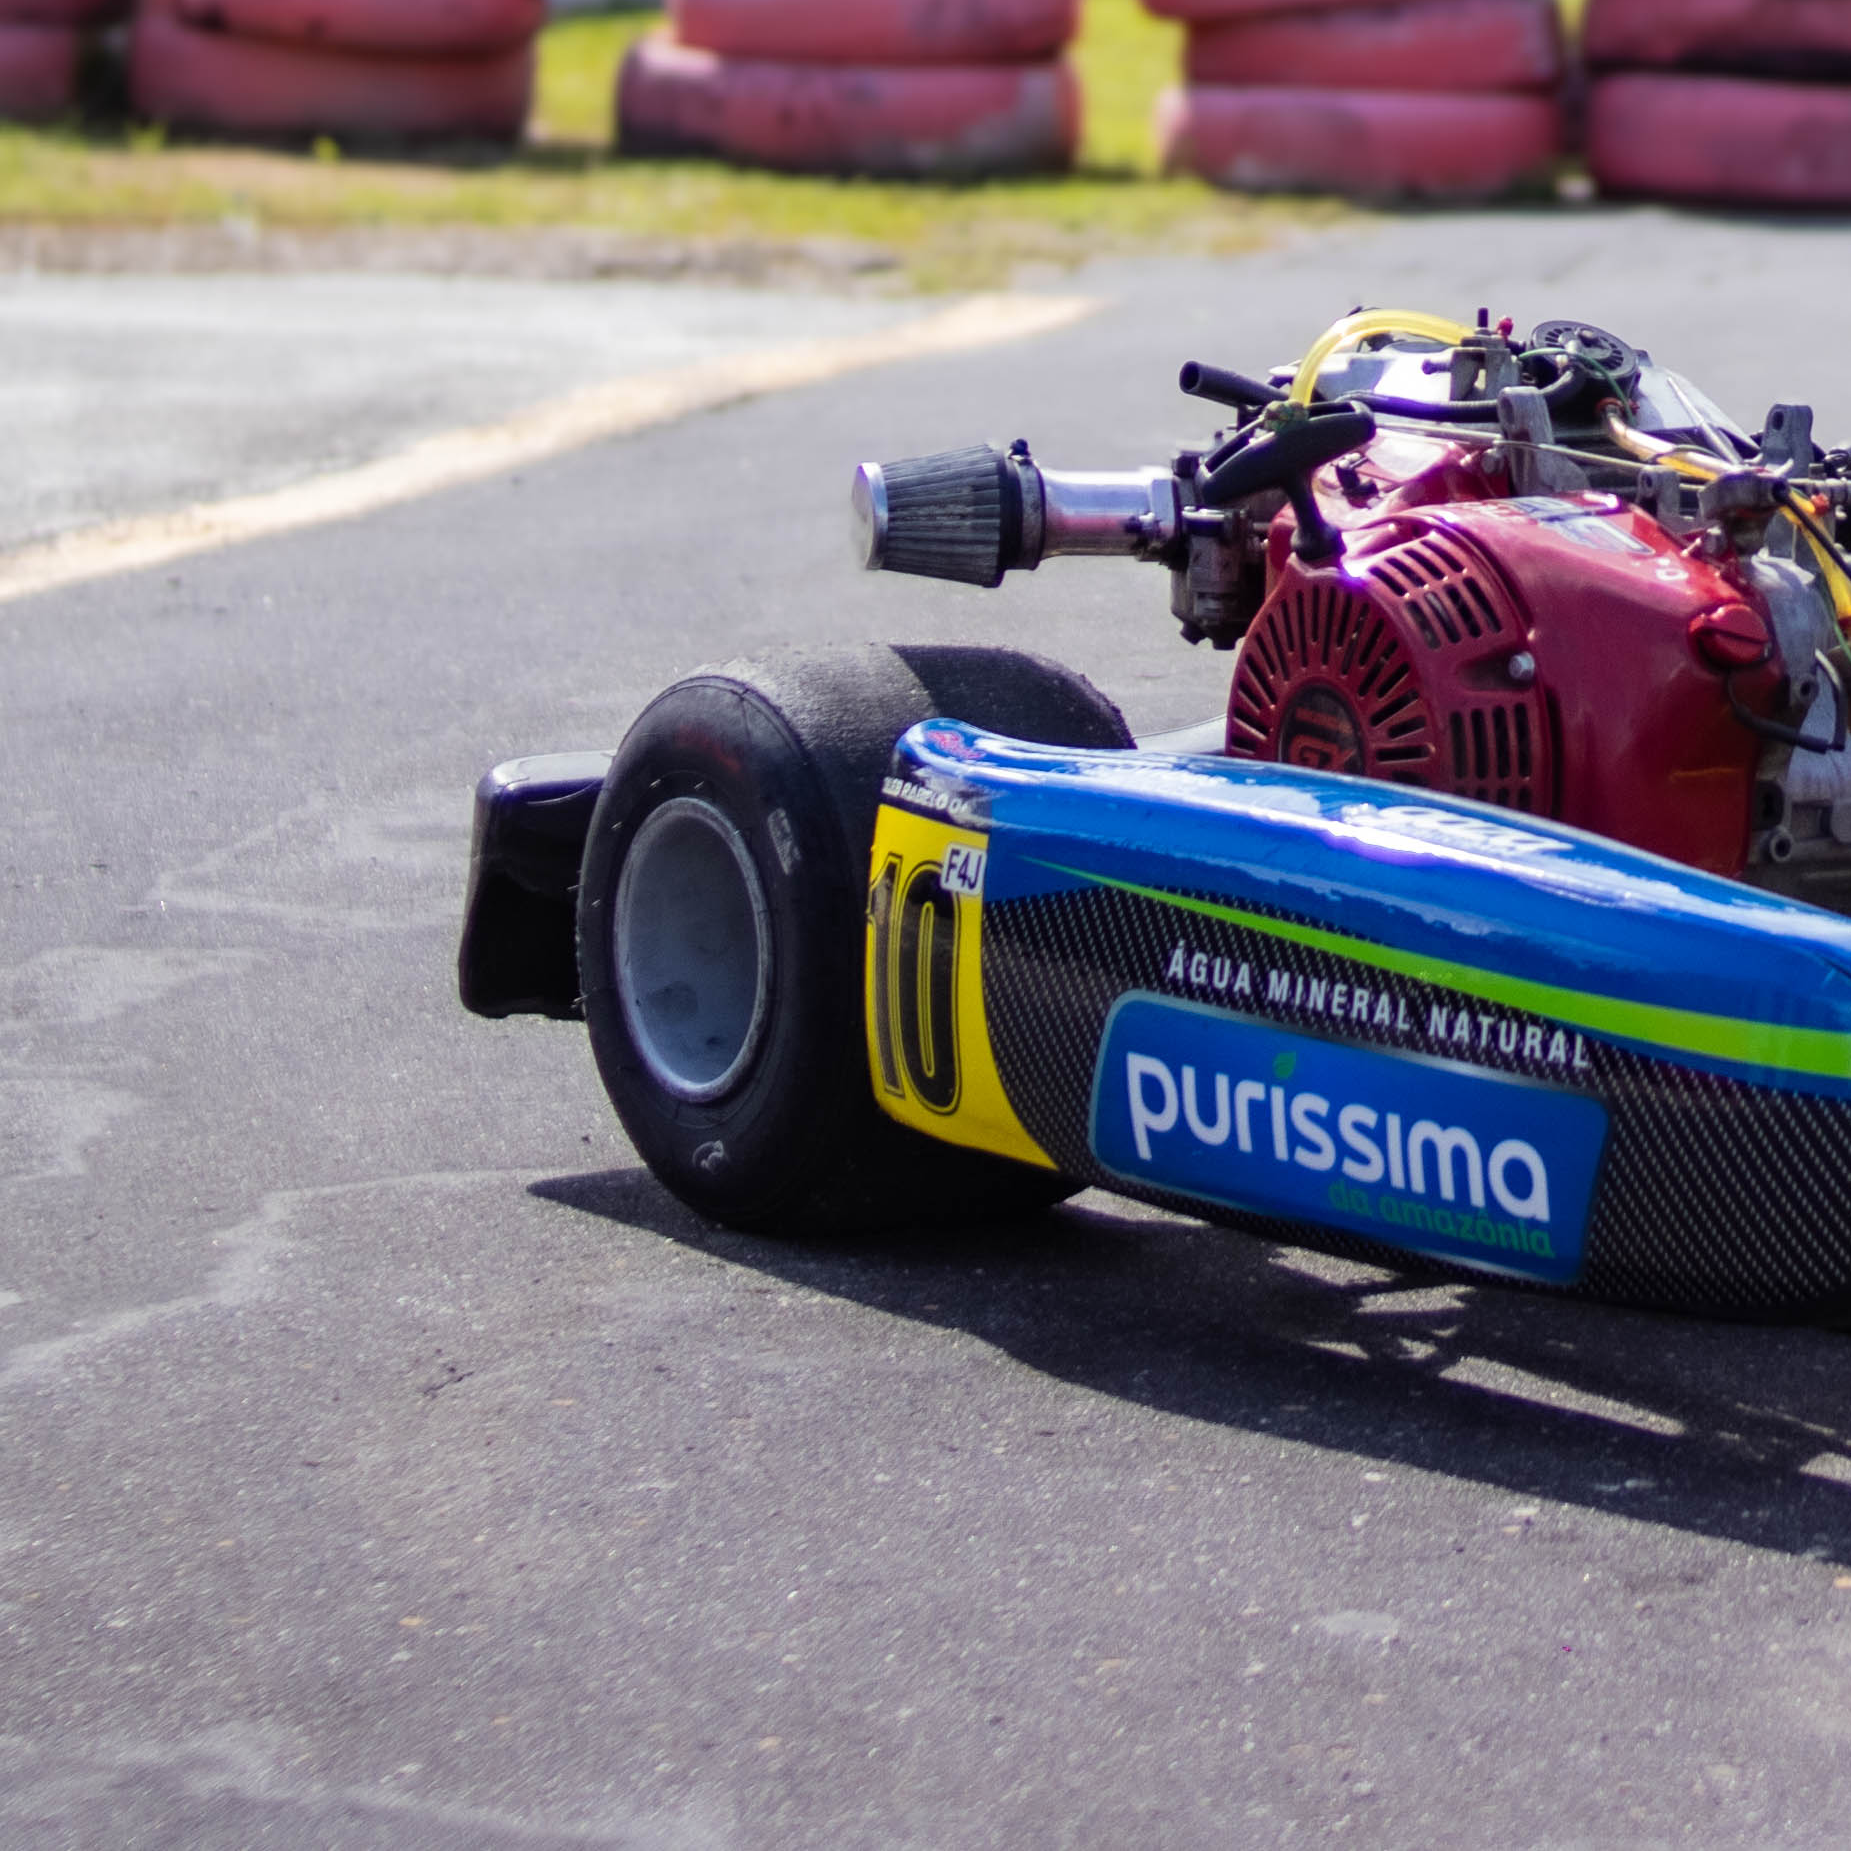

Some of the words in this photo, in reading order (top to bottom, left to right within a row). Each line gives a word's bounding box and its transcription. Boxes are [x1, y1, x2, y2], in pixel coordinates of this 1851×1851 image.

[945, 849, 984, 890] F4J
[866, 852, 961, 1117] 10
[1167, 940, 1252, 994] ÁGUA
[1267, 969, 1411, 1032] MINERAL
[1428, 1004, 1589, 1069] NATURAL
